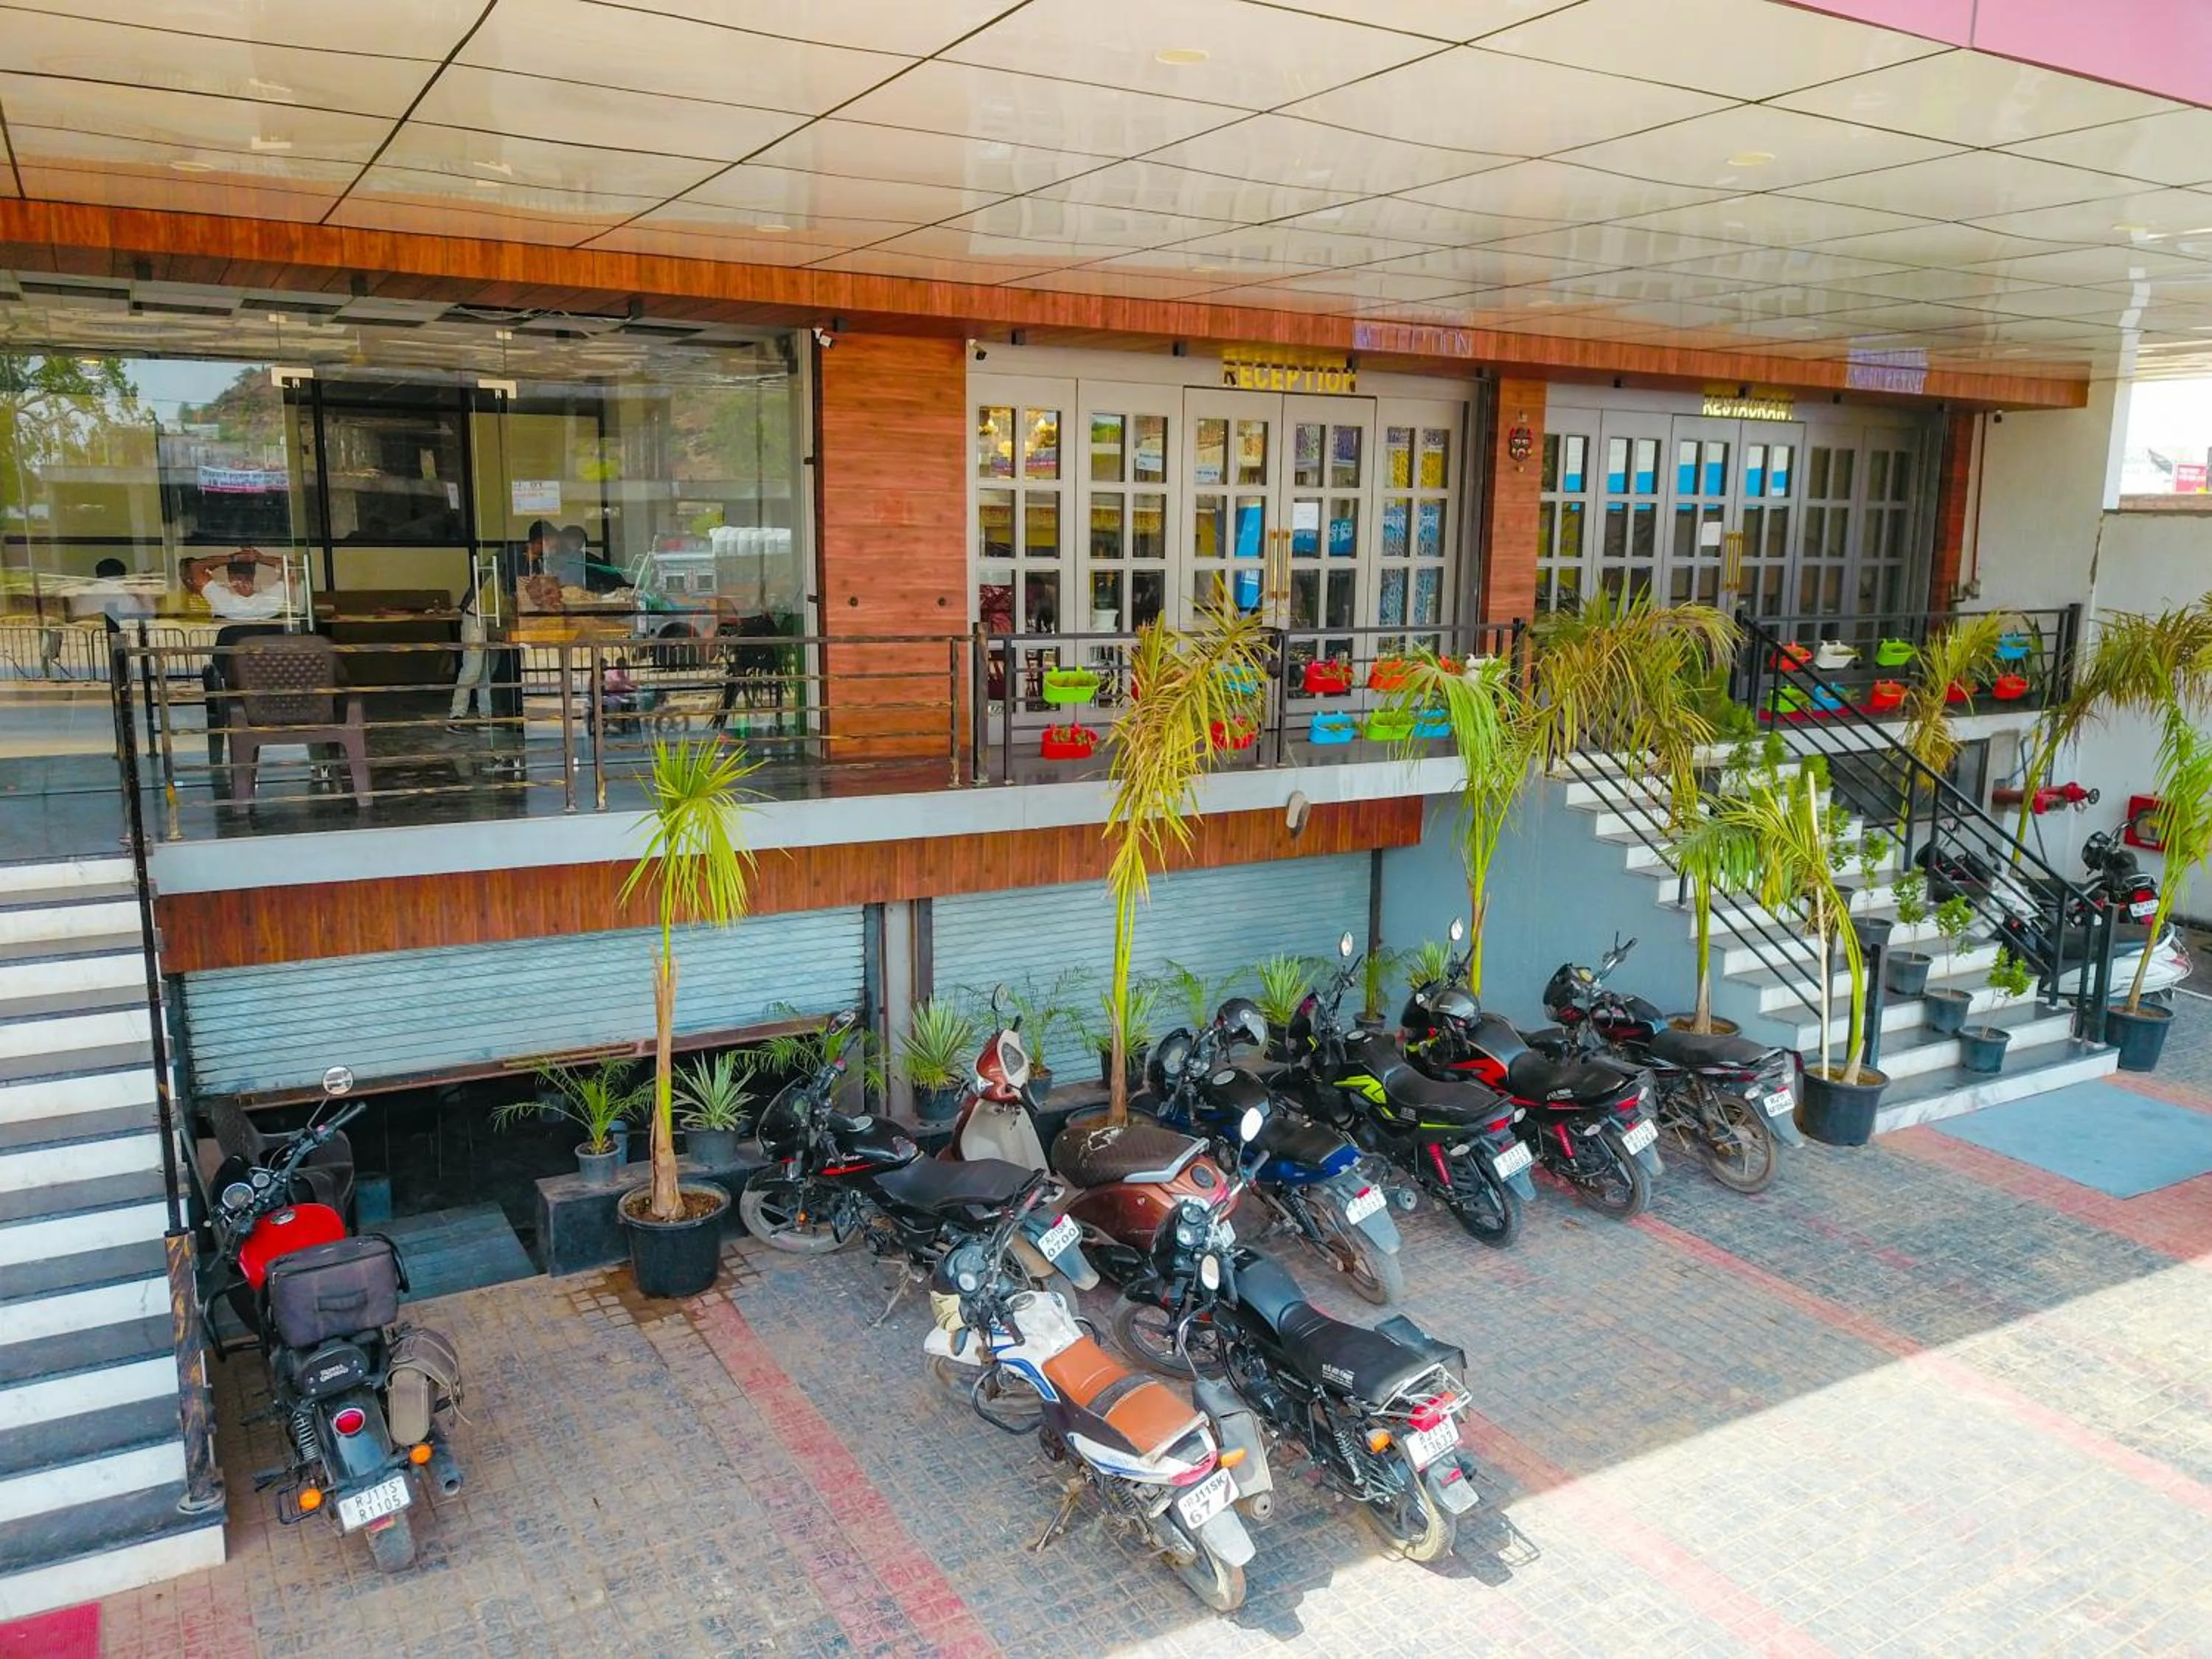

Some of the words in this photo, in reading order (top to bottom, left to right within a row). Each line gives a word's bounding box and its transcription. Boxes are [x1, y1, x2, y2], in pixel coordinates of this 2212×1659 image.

[1222, 361, 1357, 392] RECEPTION
[1048, 1227, 1077, 1257] 0700
[359, 1495, 400, 1523] R1105
